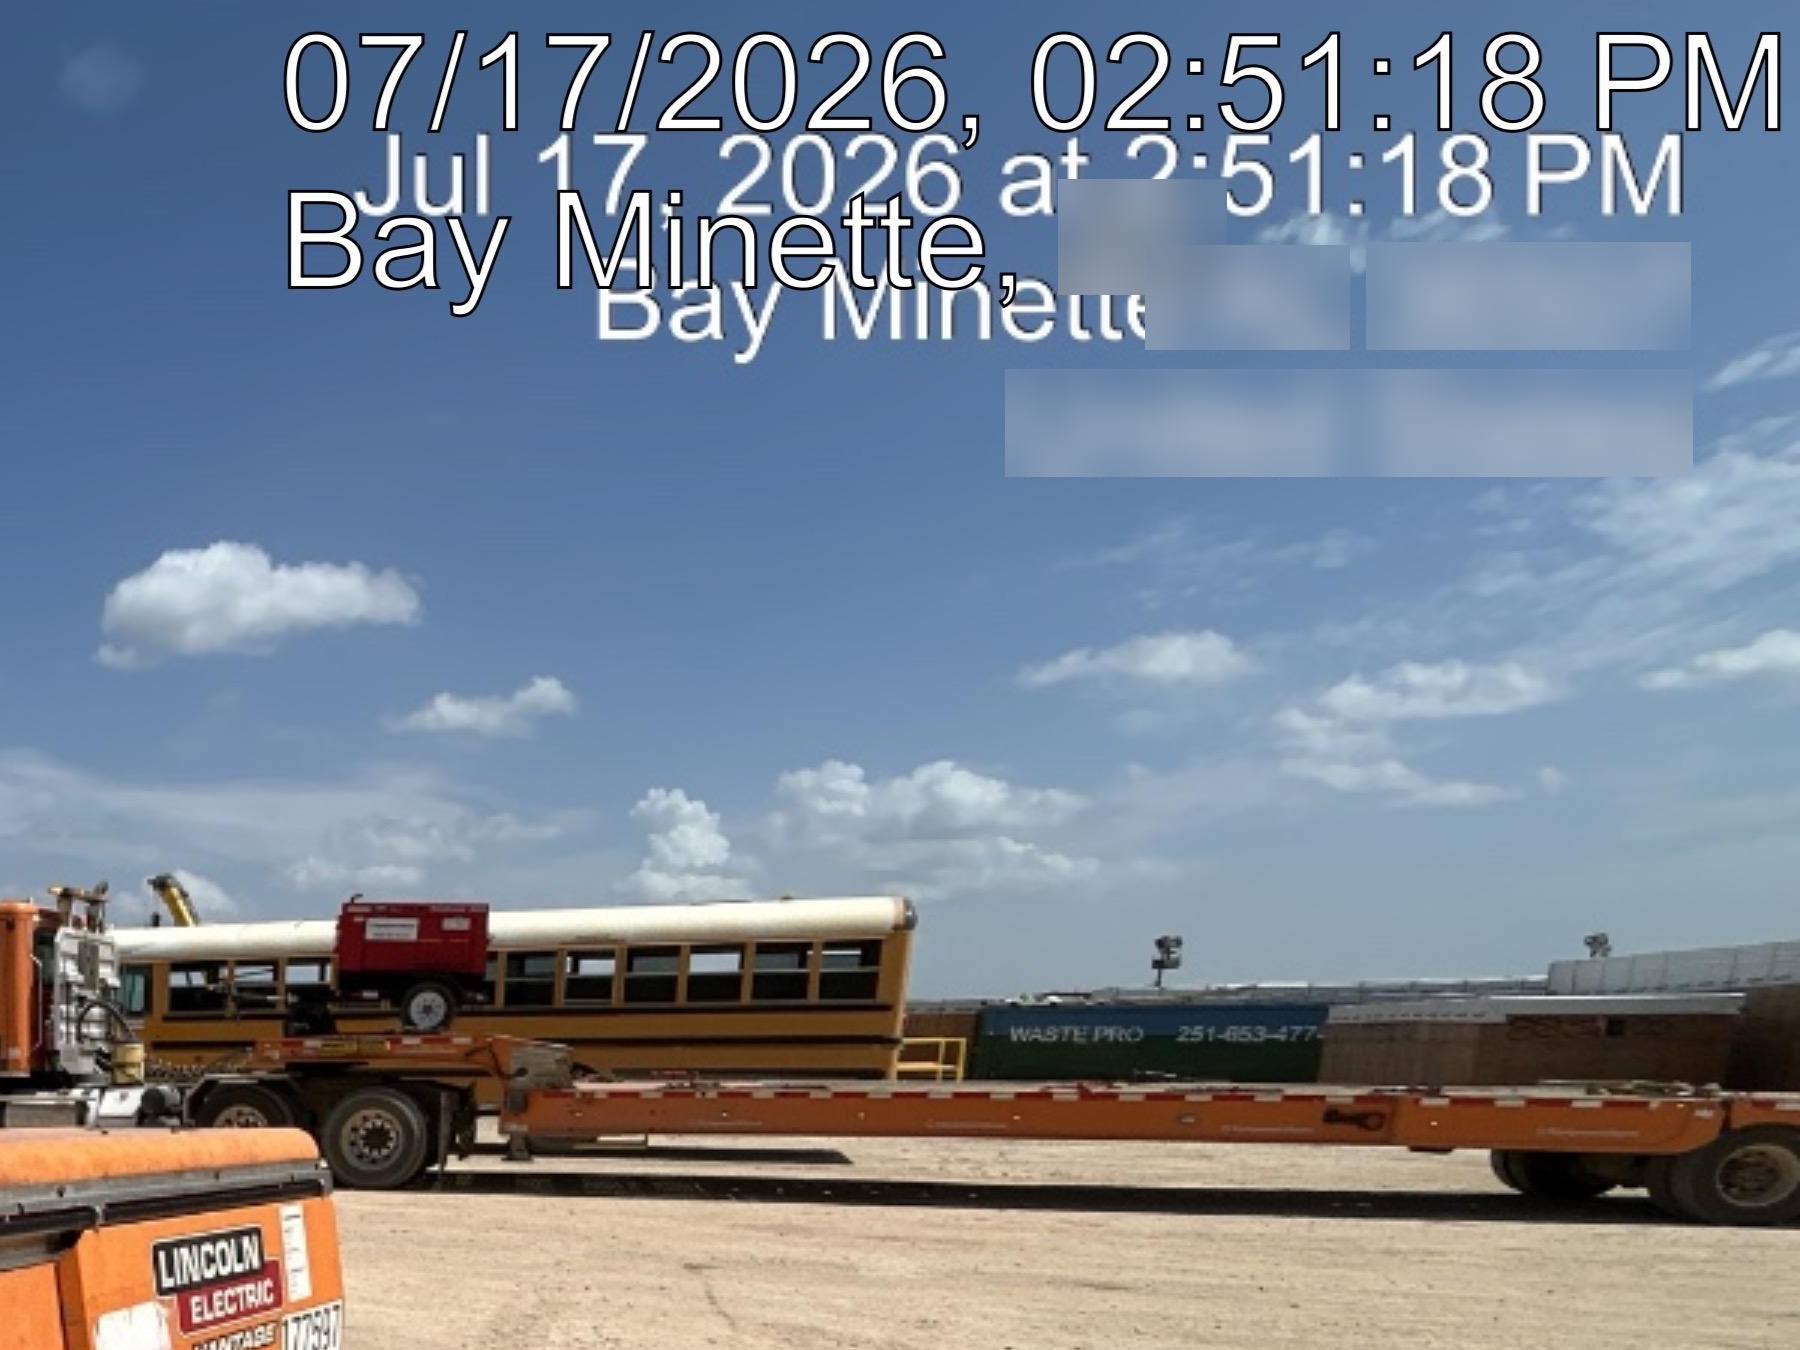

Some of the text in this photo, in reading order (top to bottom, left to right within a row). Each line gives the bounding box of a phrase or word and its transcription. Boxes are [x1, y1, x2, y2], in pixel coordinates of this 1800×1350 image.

[1009, 1024, 1327, 1043] WASTE PRO 251-653-477
[157, 1232, 260, 1289] LINCOLN
[190, 1278, 275, 1325] ELECTRIC
